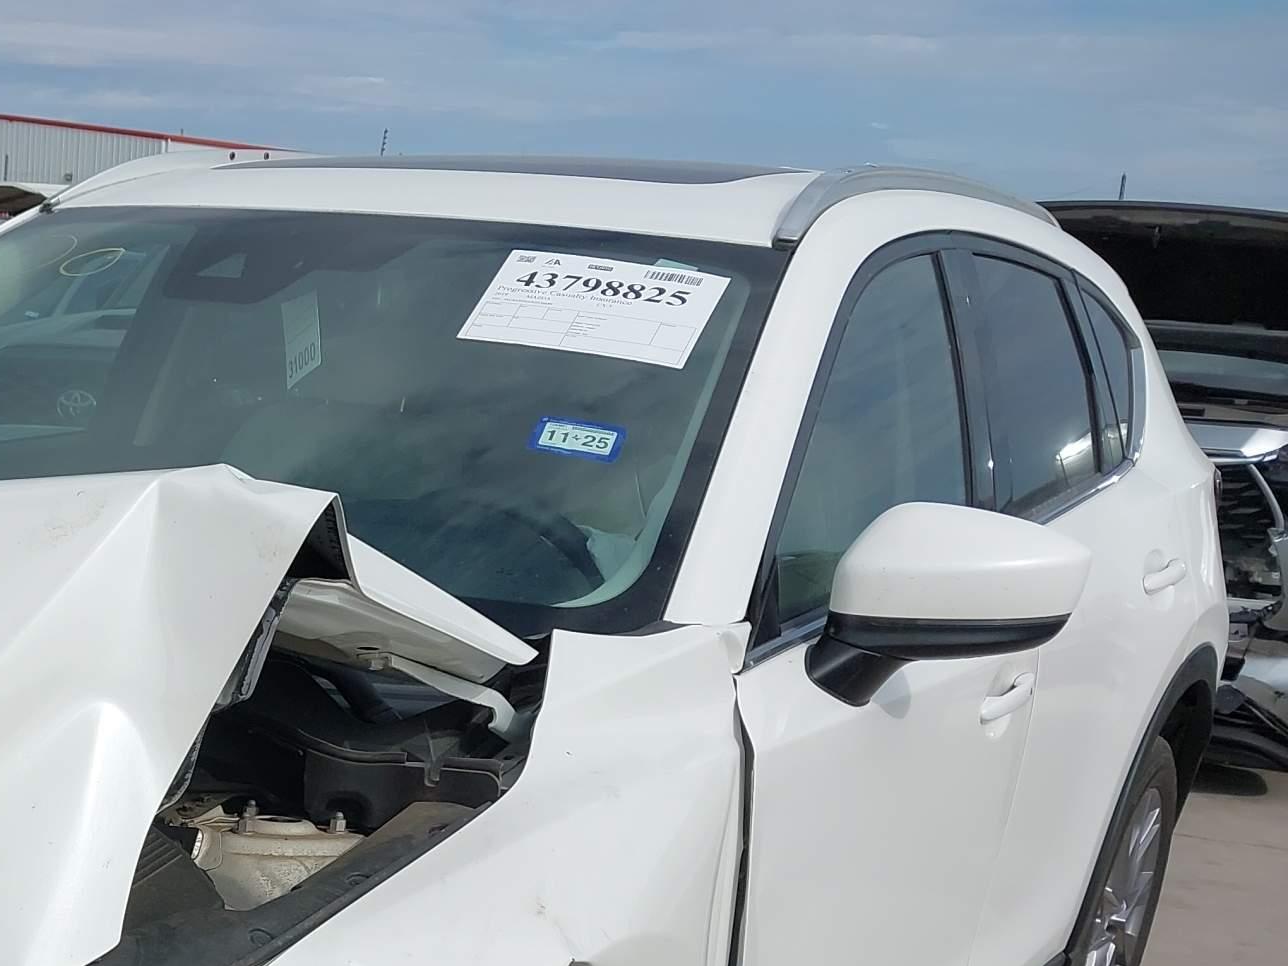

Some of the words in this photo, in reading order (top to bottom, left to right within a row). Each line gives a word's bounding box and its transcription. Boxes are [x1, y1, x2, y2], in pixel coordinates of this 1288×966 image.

[516, 271, 691, 306] 43798825
[547, 429, 570, 443] 11
[581, 434, 610, 449] 25
